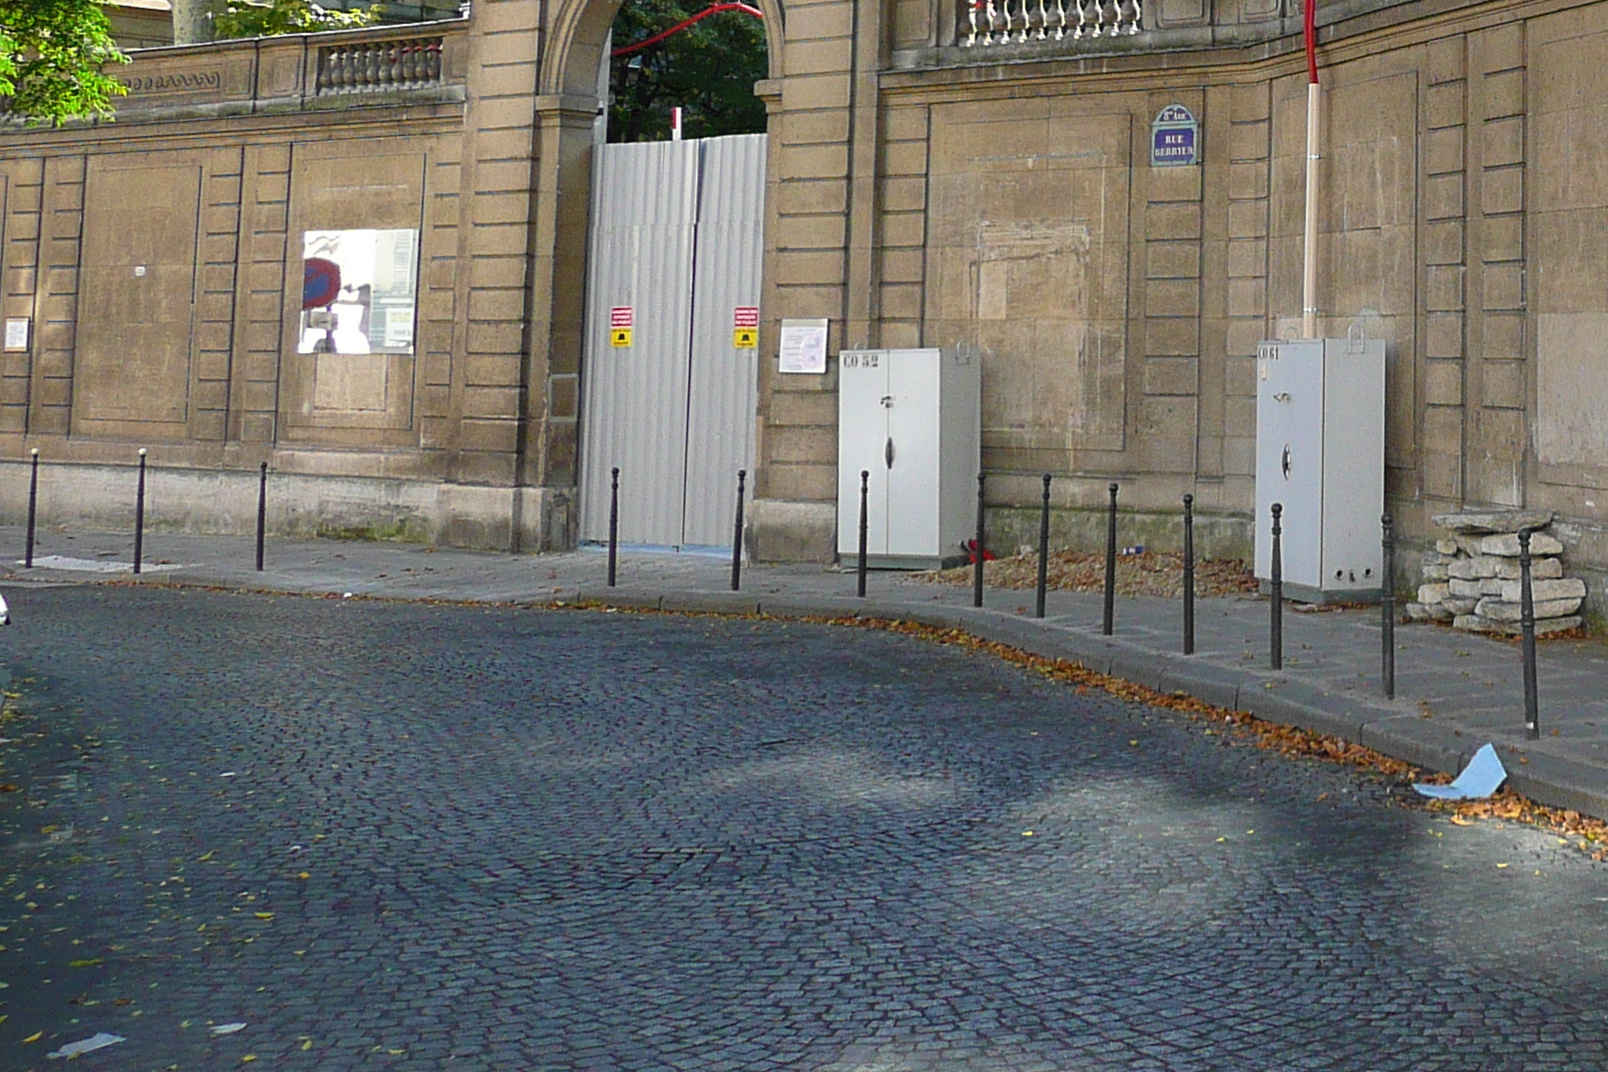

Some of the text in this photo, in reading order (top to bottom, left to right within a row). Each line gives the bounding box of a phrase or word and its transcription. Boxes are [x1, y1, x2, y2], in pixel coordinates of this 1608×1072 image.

[1165, 134, 1185, 145] RUE
[1154, 146, 1194, 157] BERRYER
[843, 355, 859, 368] CO
